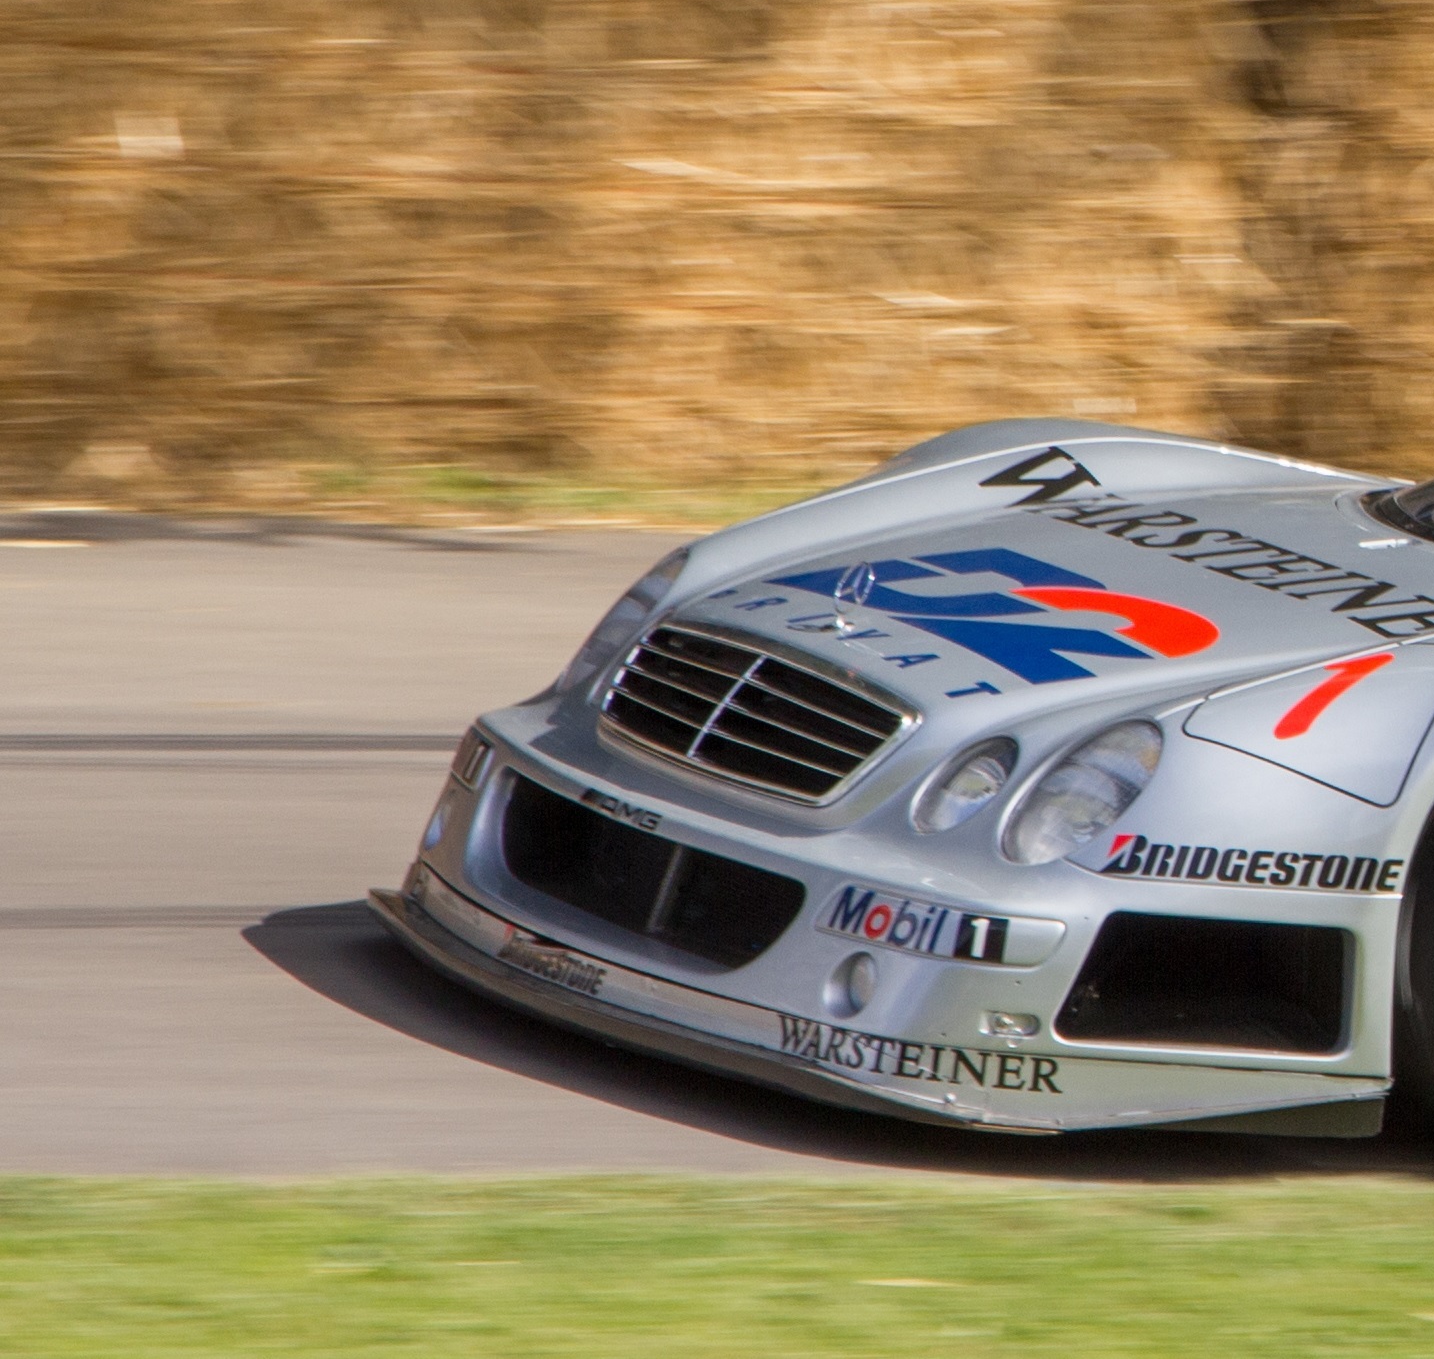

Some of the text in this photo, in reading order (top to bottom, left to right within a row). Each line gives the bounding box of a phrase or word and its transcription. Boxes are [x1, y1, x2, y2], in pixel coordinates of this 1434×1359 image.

[1273, 652, 1395, 740] 1
[1101, 835, 1404, 893] BRIDGESTONE
[828, 885, 950, 954] Mobil
[778, 1014, 1063, 1093] WARSTEINER
